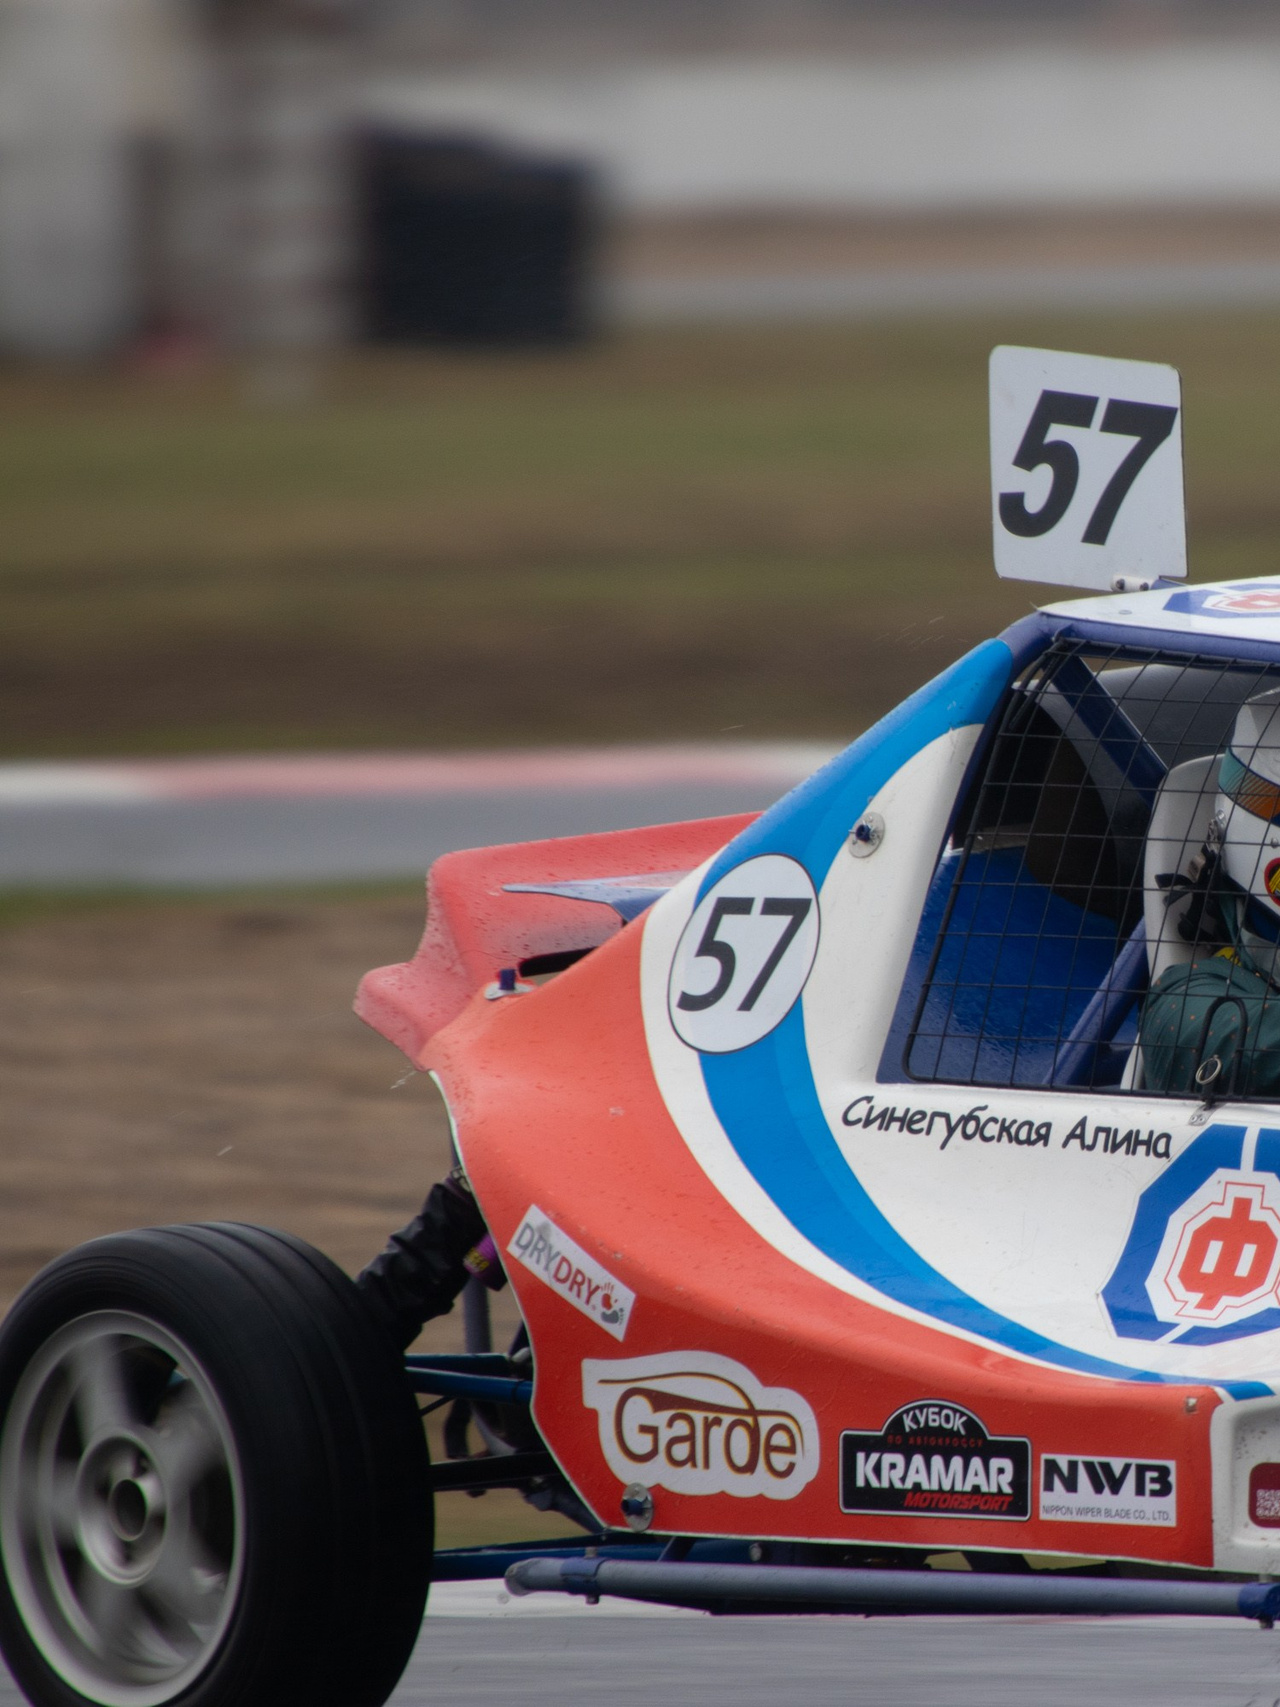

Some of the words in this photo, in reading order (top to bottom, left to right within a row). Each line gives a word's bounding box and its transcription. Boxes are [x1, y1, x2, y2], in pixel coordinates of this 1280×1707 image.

[999, 389, 1178, 546] 57
[676, 897, 812, 1012] 57
[842, 1096, 1052, 1150] Синегубская
[1061, 1116, 1173, 1160] Алина
[614, 1387, 797, 1478] Garde
[902, 1407, 968, 1435] КУБОК
[856, 1452, 1014, 1494] KRAMAR
[1042, 1458, 1173, 1498] NWB
[903, 1492, 1014, 1511] MOTORSPORT
[1042, 1504, 1073, 1516] NIPPON
[1075, 1506, 1102, 1518] WIPER
[1104, 1507, 1131, 1519] BLADE
[1152, 1510, 1171, 1521] LTD.
